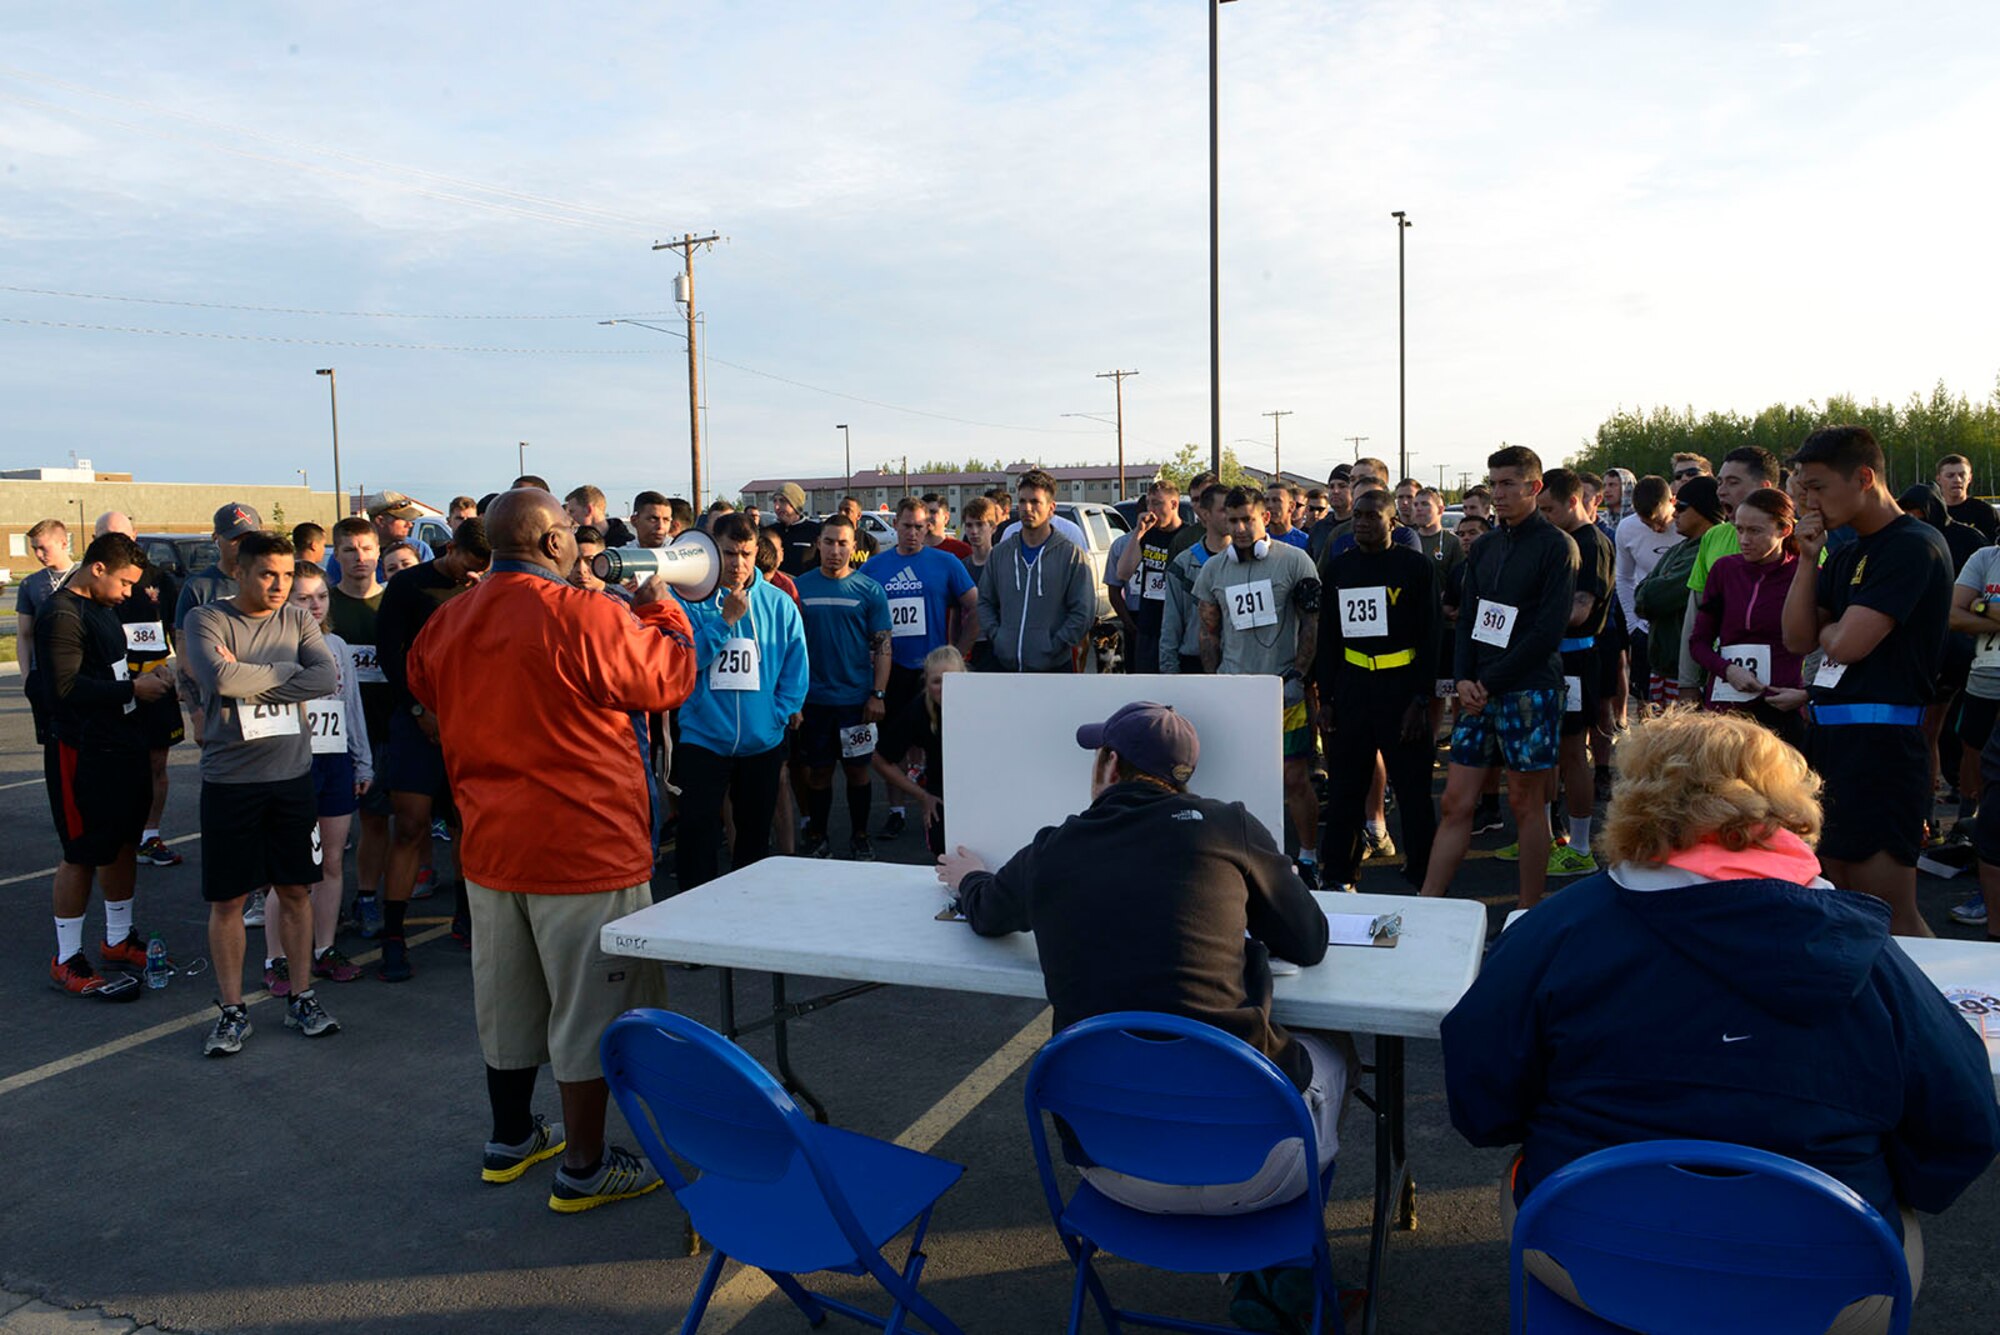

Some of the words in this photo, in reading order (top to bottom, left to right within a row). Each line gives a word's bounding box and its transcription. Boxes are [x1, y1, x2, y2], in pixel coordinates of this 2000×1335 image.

[850, 551, 869, 563] MY
[885, 580, 922, 591] adidas
[1236, 591, 1264, 615] 291
[1387, 587, 1401, 605] Y
[893, 606, 917, 625] 202
[1347, 599, 1377, 622] 235
[1483, 610, 1506, 631] 310
[133, 630, 157, 642] 384
[1984, 632, 2000, 652] 2
[352, 653, 378, 669] 344
[718, 650, 751, 674] 250
[308, 712, 340, 737] 272
[850, 731, 872, 746] 366
